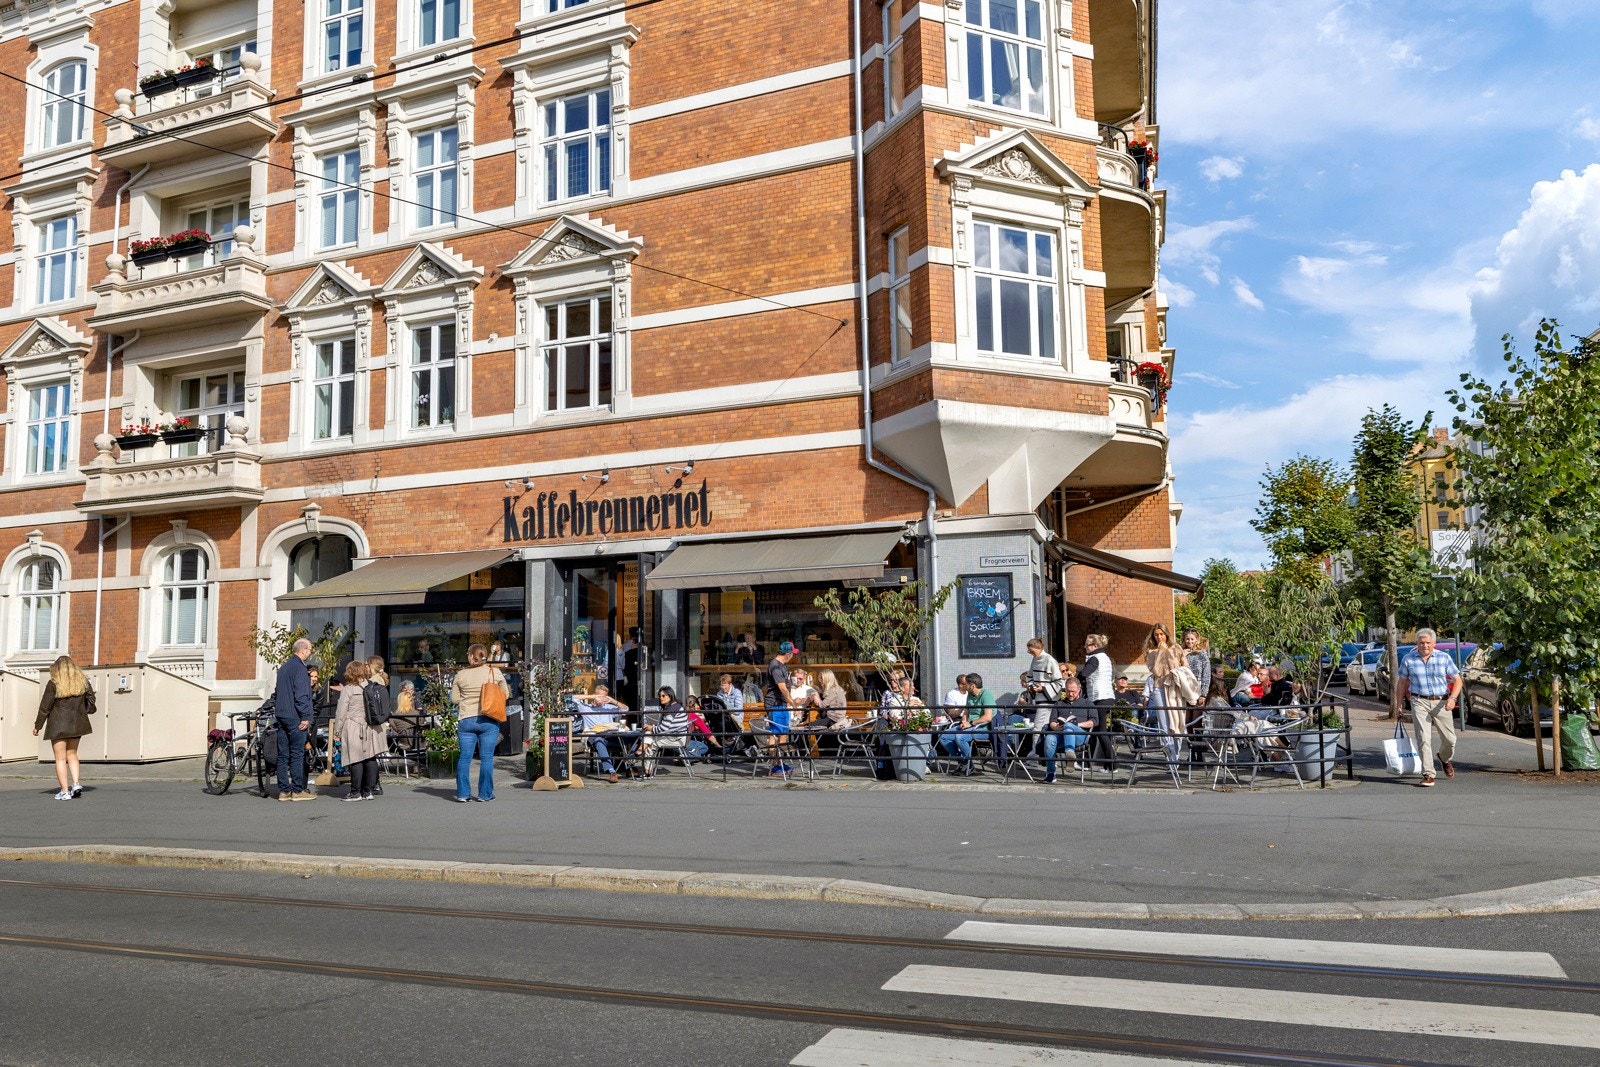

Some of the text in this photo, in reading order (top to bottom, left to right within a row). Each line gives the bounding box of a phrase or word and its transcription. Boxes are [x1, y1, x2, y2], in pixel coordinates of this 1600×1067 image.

[502, 477, 713, 543] Kaffebrenneriet
[984, 557, 1025, 565] Frognerveien
[966, 587, 1001, 600] ISKREM
